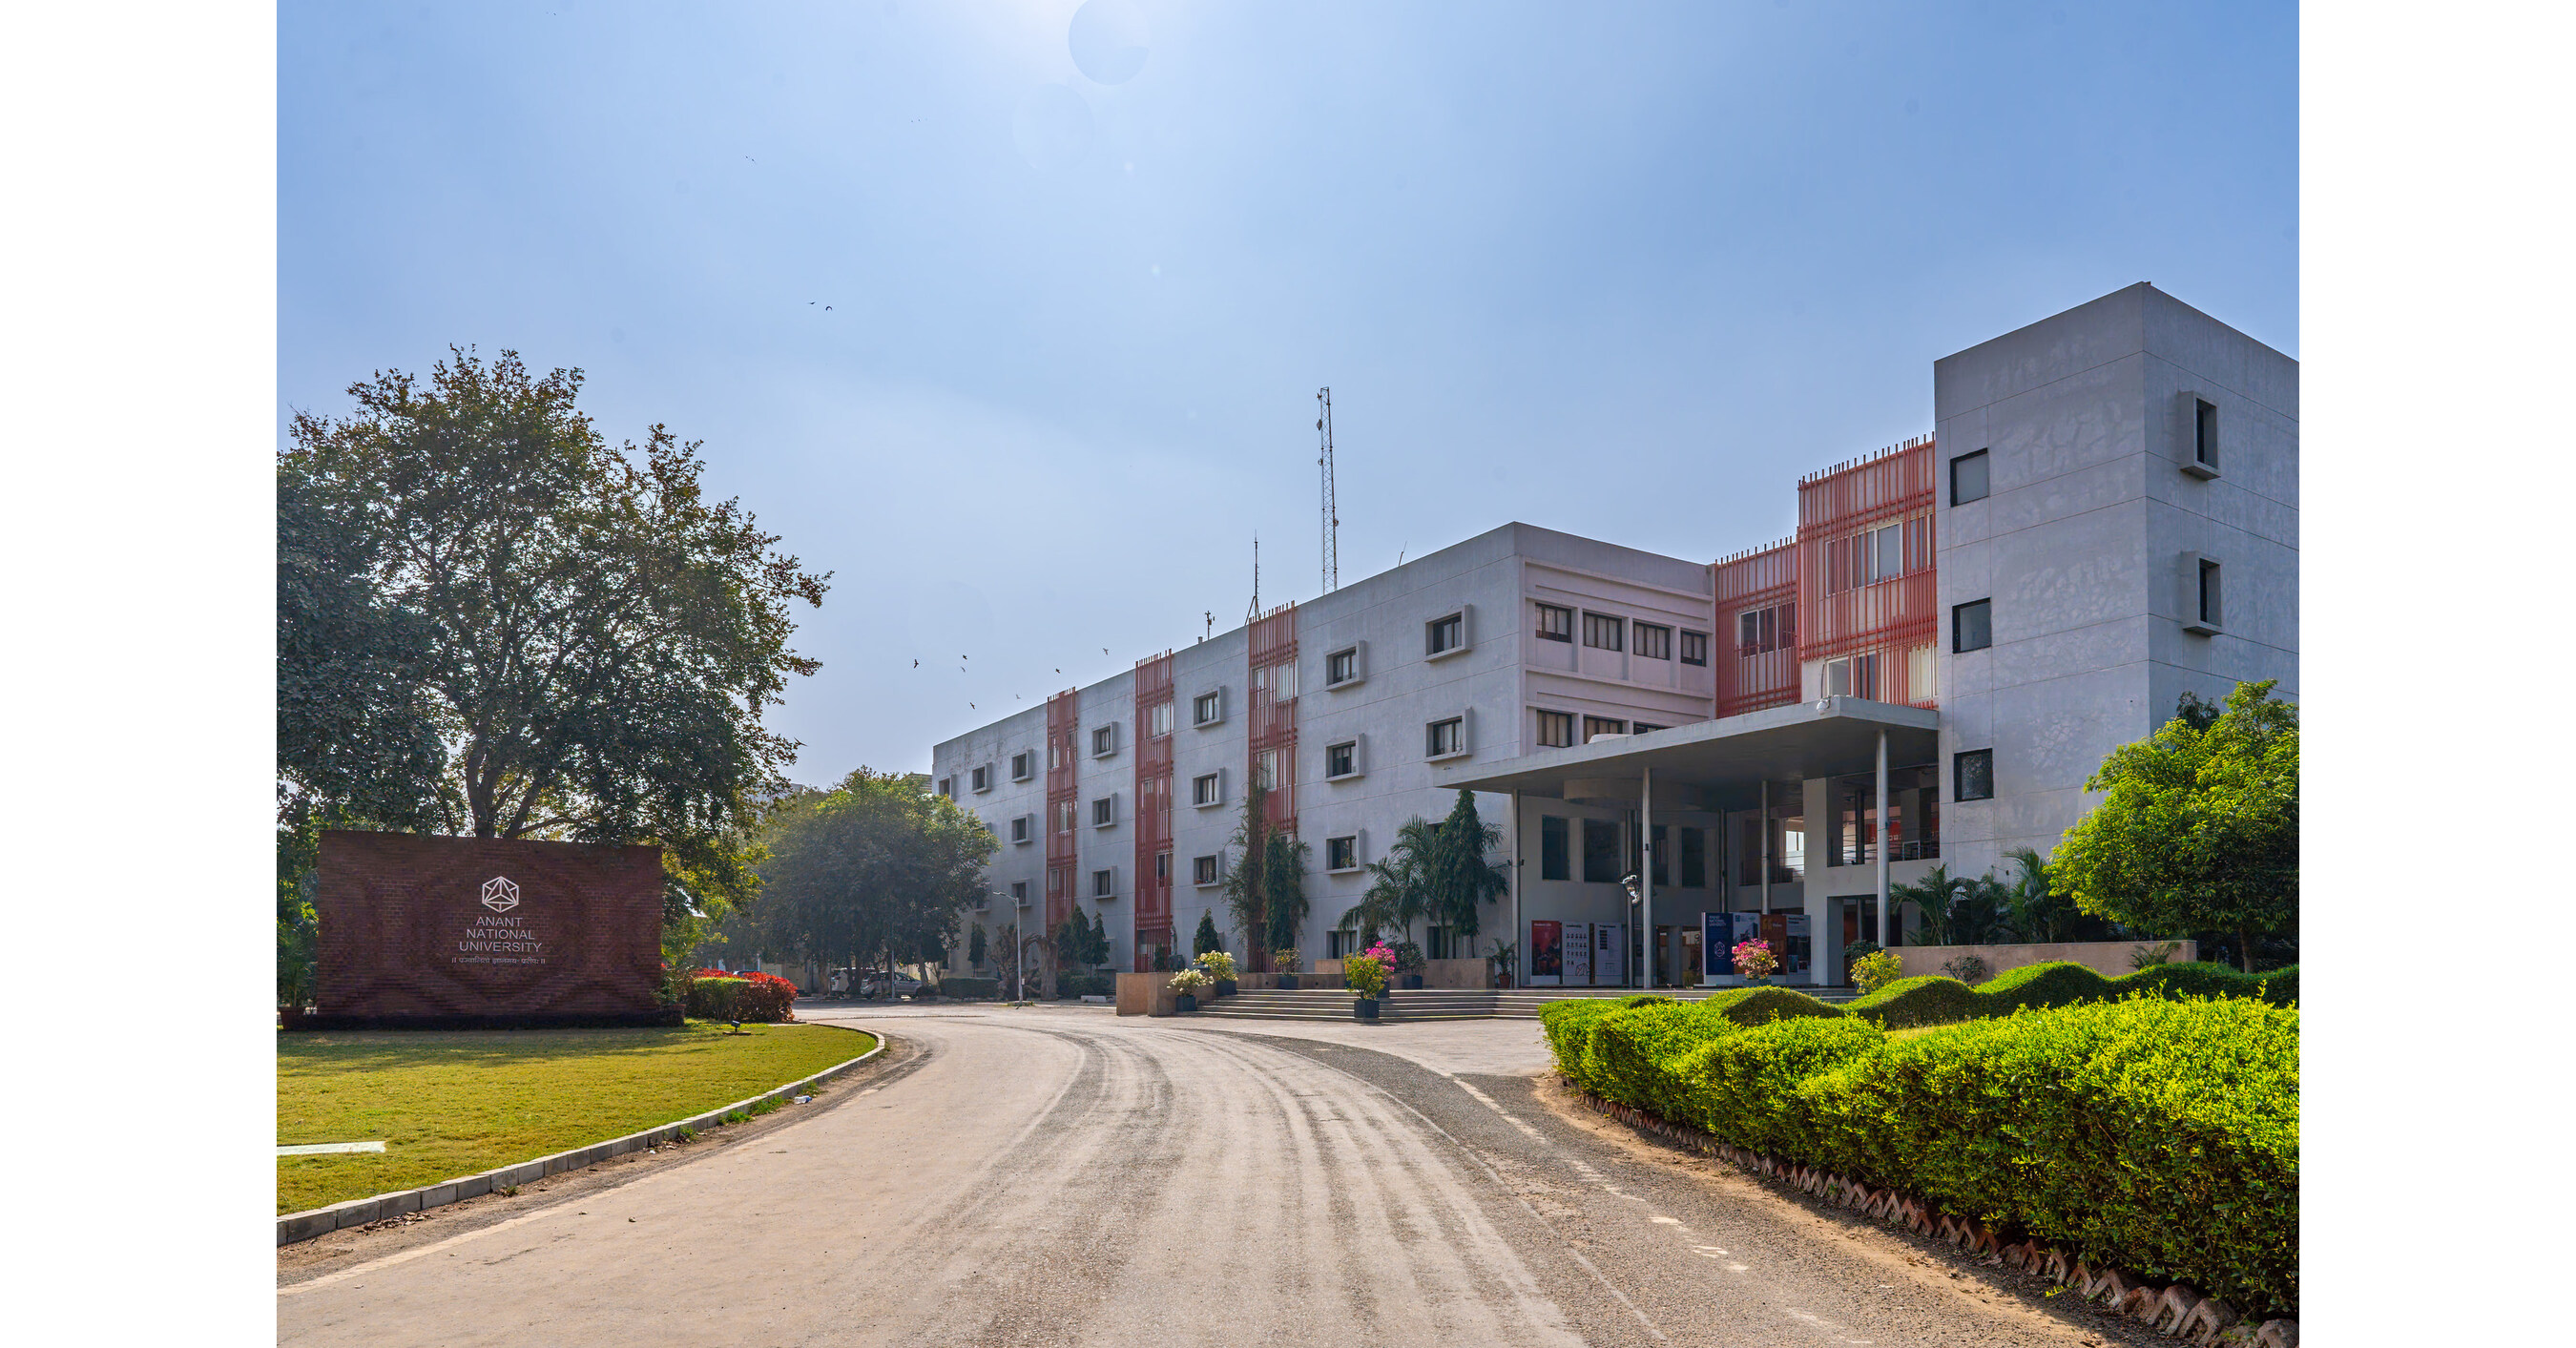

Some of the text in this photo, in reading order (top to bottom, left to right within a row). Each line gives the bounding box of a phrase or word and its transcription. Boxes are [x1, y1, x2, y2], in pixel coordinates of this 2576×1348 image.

[475, 916, 524, 927] ANANT
[466, 928, 535, 941] NATIONAL
[459, 941, 543, 953] UNIVERSITY
